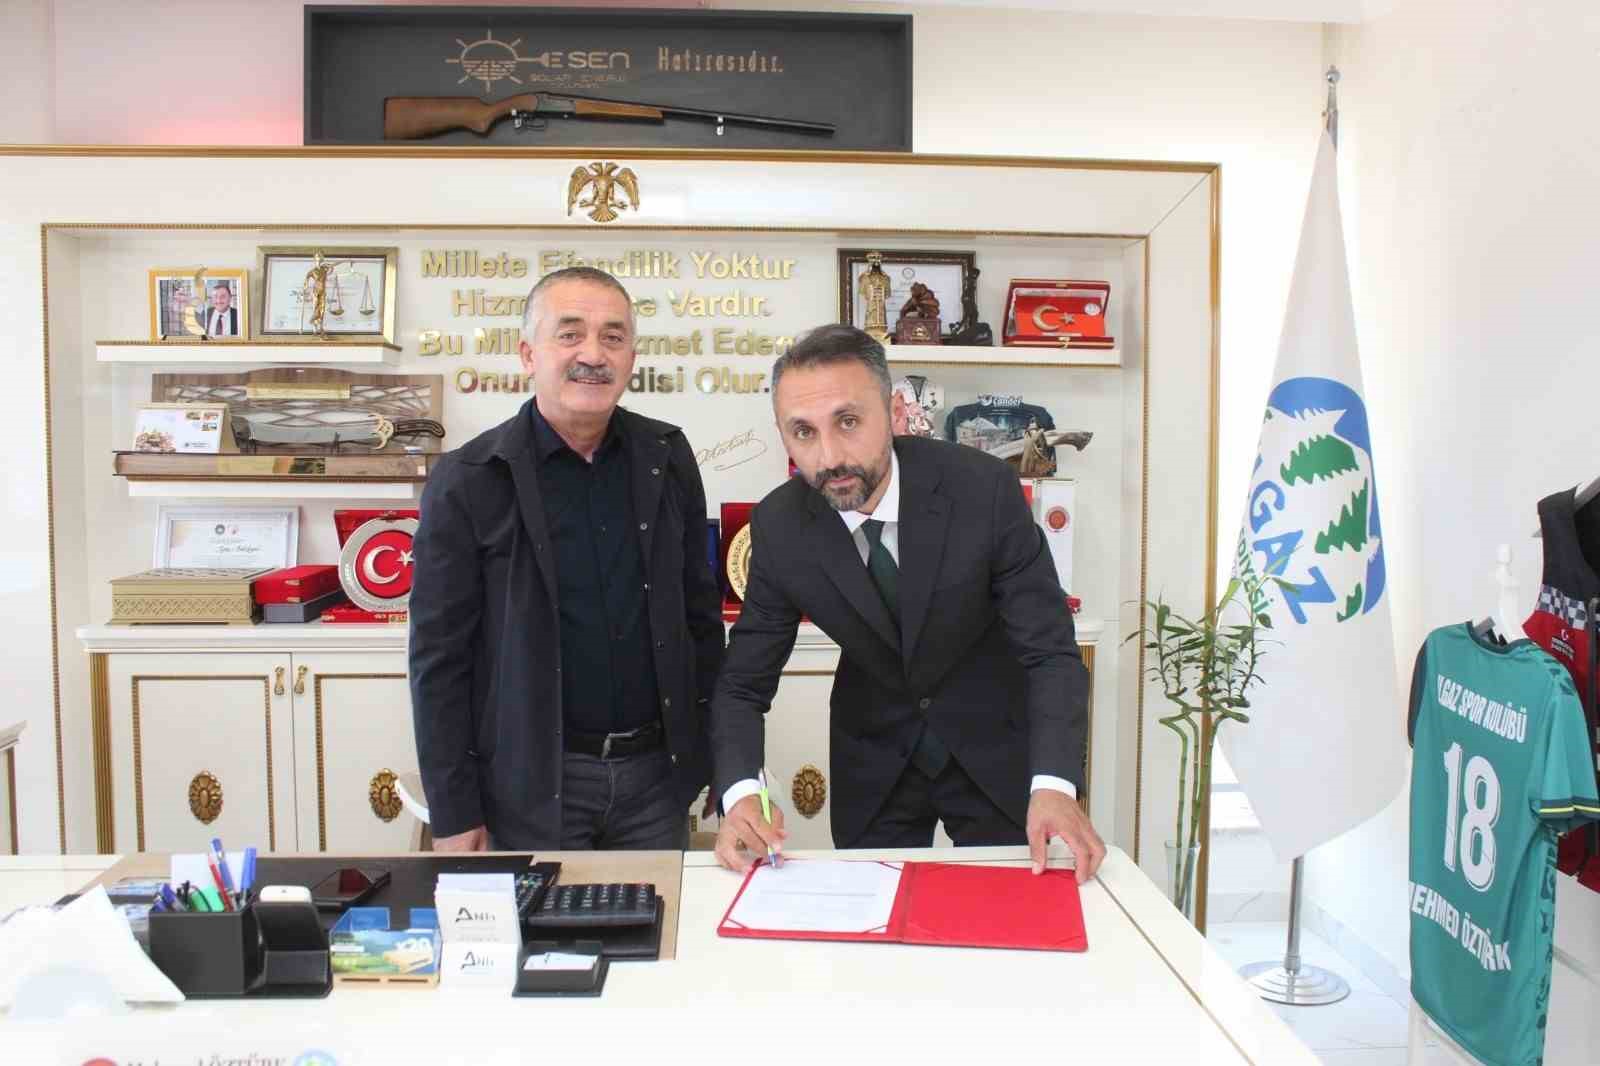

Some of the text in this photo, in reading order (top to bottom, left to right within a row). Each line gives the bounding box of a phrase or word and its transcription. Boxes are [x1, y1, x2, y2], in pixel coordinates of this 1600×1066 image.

[421, 250, 528, 278] Millete
[690, 251, 795, 279] Yoktur
[667, 288, 772, 317] Vardır.
[418, 329, 463, 355] Bu
[695, 366, 770, 393] Olur.
[1249, 479, 1337, 624] GAZ
[1458, 687, 1488, 726] SPOR
[1482, 700, 1528, 744] KULÜBÜ
[1443, 742, 1502, 893] 18
[1408, 880, 1460, 939] EHMED
